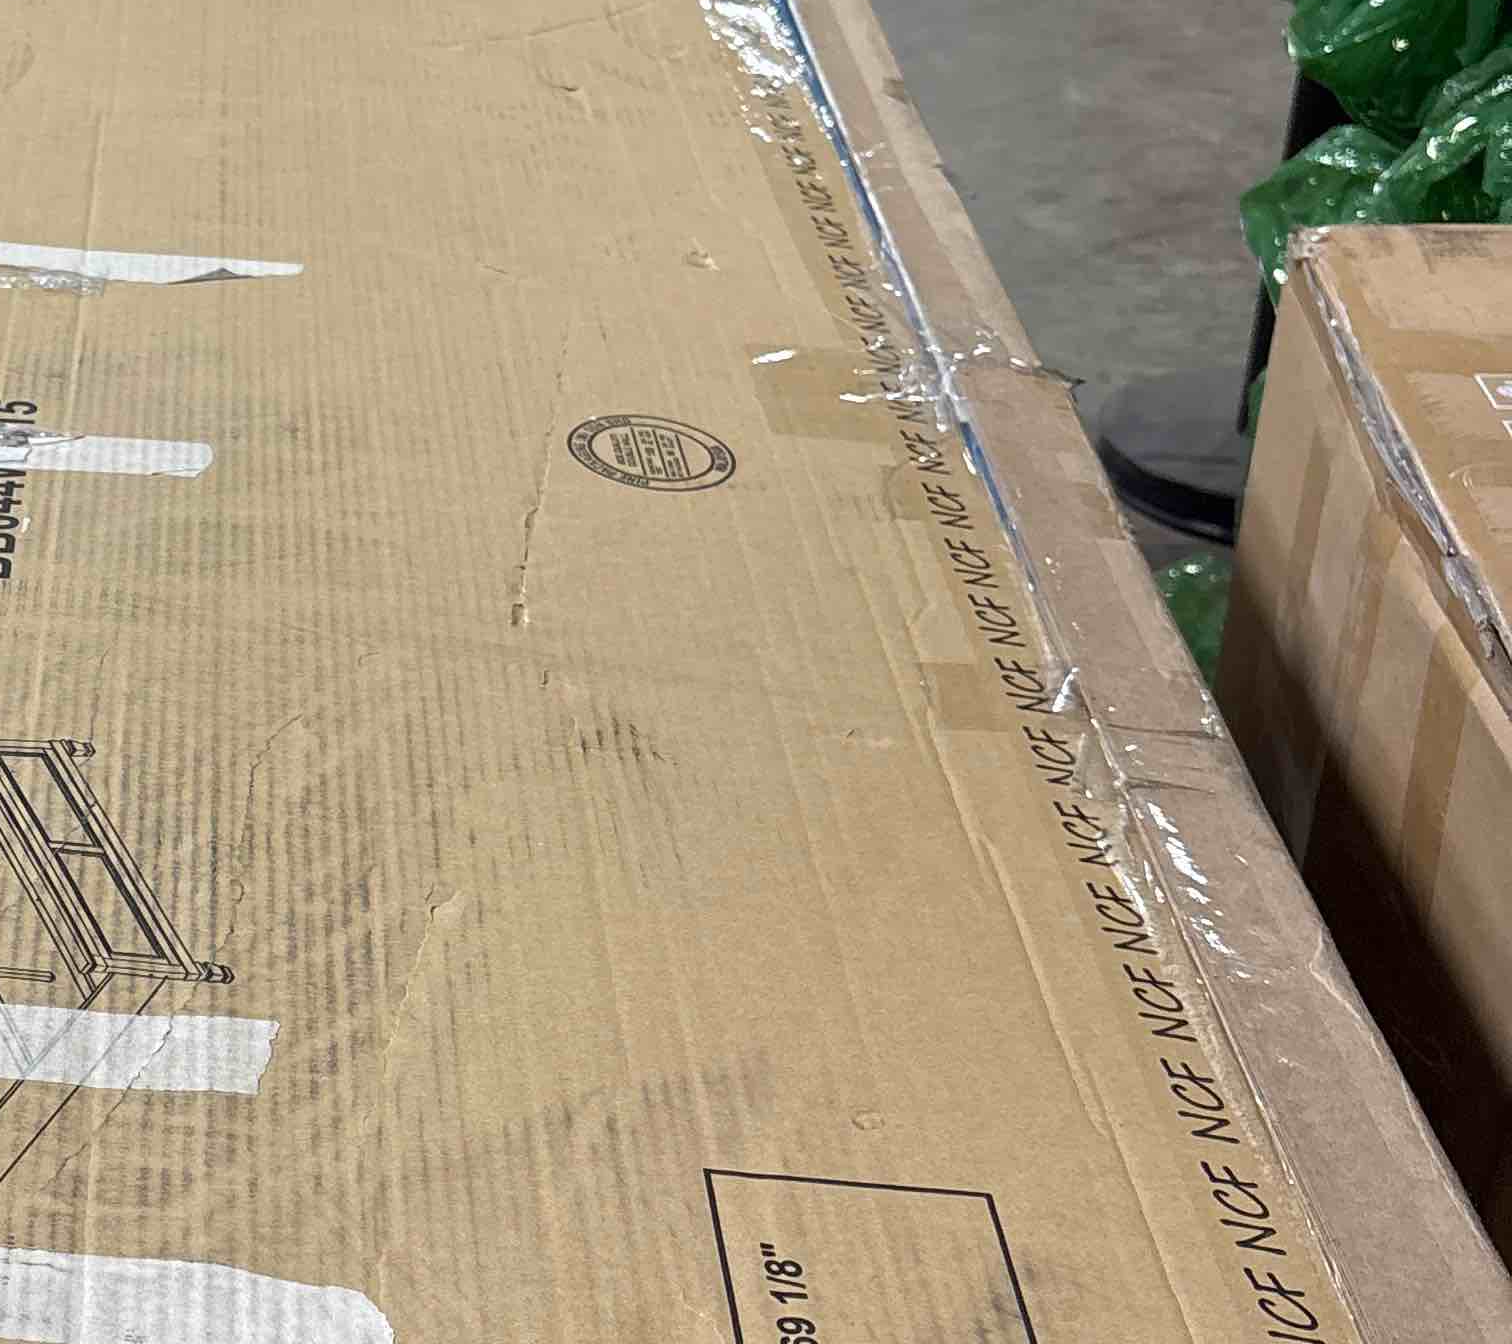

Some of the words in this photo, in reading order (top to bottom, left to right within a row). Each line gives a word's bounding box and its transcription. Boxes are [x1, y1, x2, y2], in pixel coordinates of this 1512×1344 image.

[796, 179, 837, 213] NCF
[810, 215, 854, 250] NCF
[828, 254, 869, 290] NCF
[845, 295, 891, 334] NCF
[900, 430, 952, 476] NCF
[921, 481, 975, 531] NCF
[944, 537, 999, 588] NCF
[967, 593, 1027, 648] NCF
[994, 657, 1055, 714] NCF
[1022, 725, 1077, 786] NCF
[1053, 800, 1118, 867] NCF
[1086, 881, 1161, 956] NCF
[1123, 963, 1198, 1042] NCF
[1160, 1057, 1240, 1144] NCF
[1200, 1161, 1288, 1256] NCF
[759, 1242, 809, 1304] 1/8"
